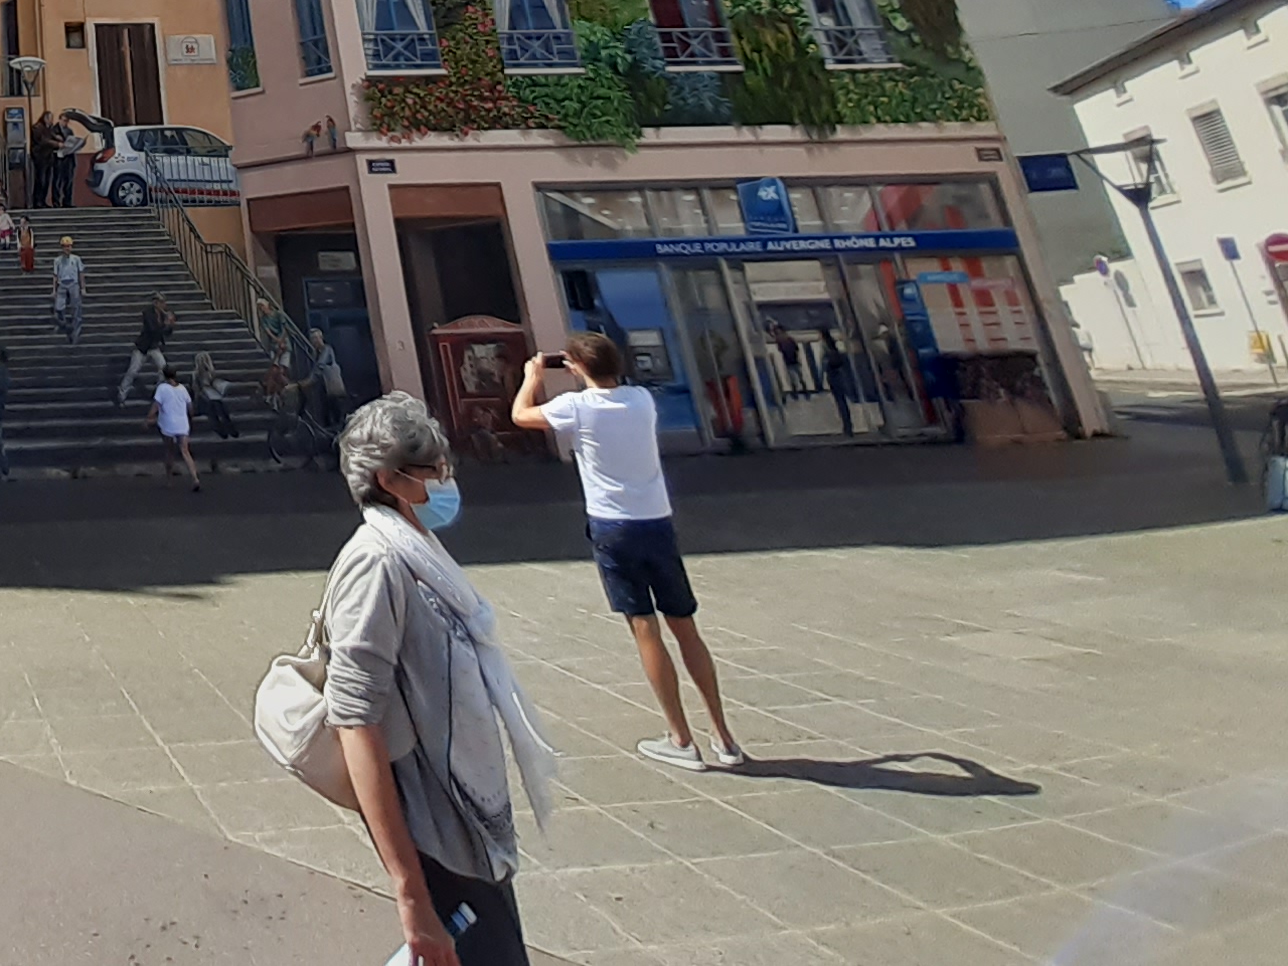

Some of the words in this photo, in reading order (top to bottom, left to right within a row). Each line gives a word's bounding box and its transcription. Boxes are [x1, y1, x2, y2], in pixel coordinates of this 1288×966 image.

[655, 242, 704, 255] BANQUE
[704, 241, 762, 253] POPULAIRE
[766, 239, 831, 251] AUVERGNE
[834, 236, 877, 249] RHÔNE
[878, 237, 916, 248] ALPES
